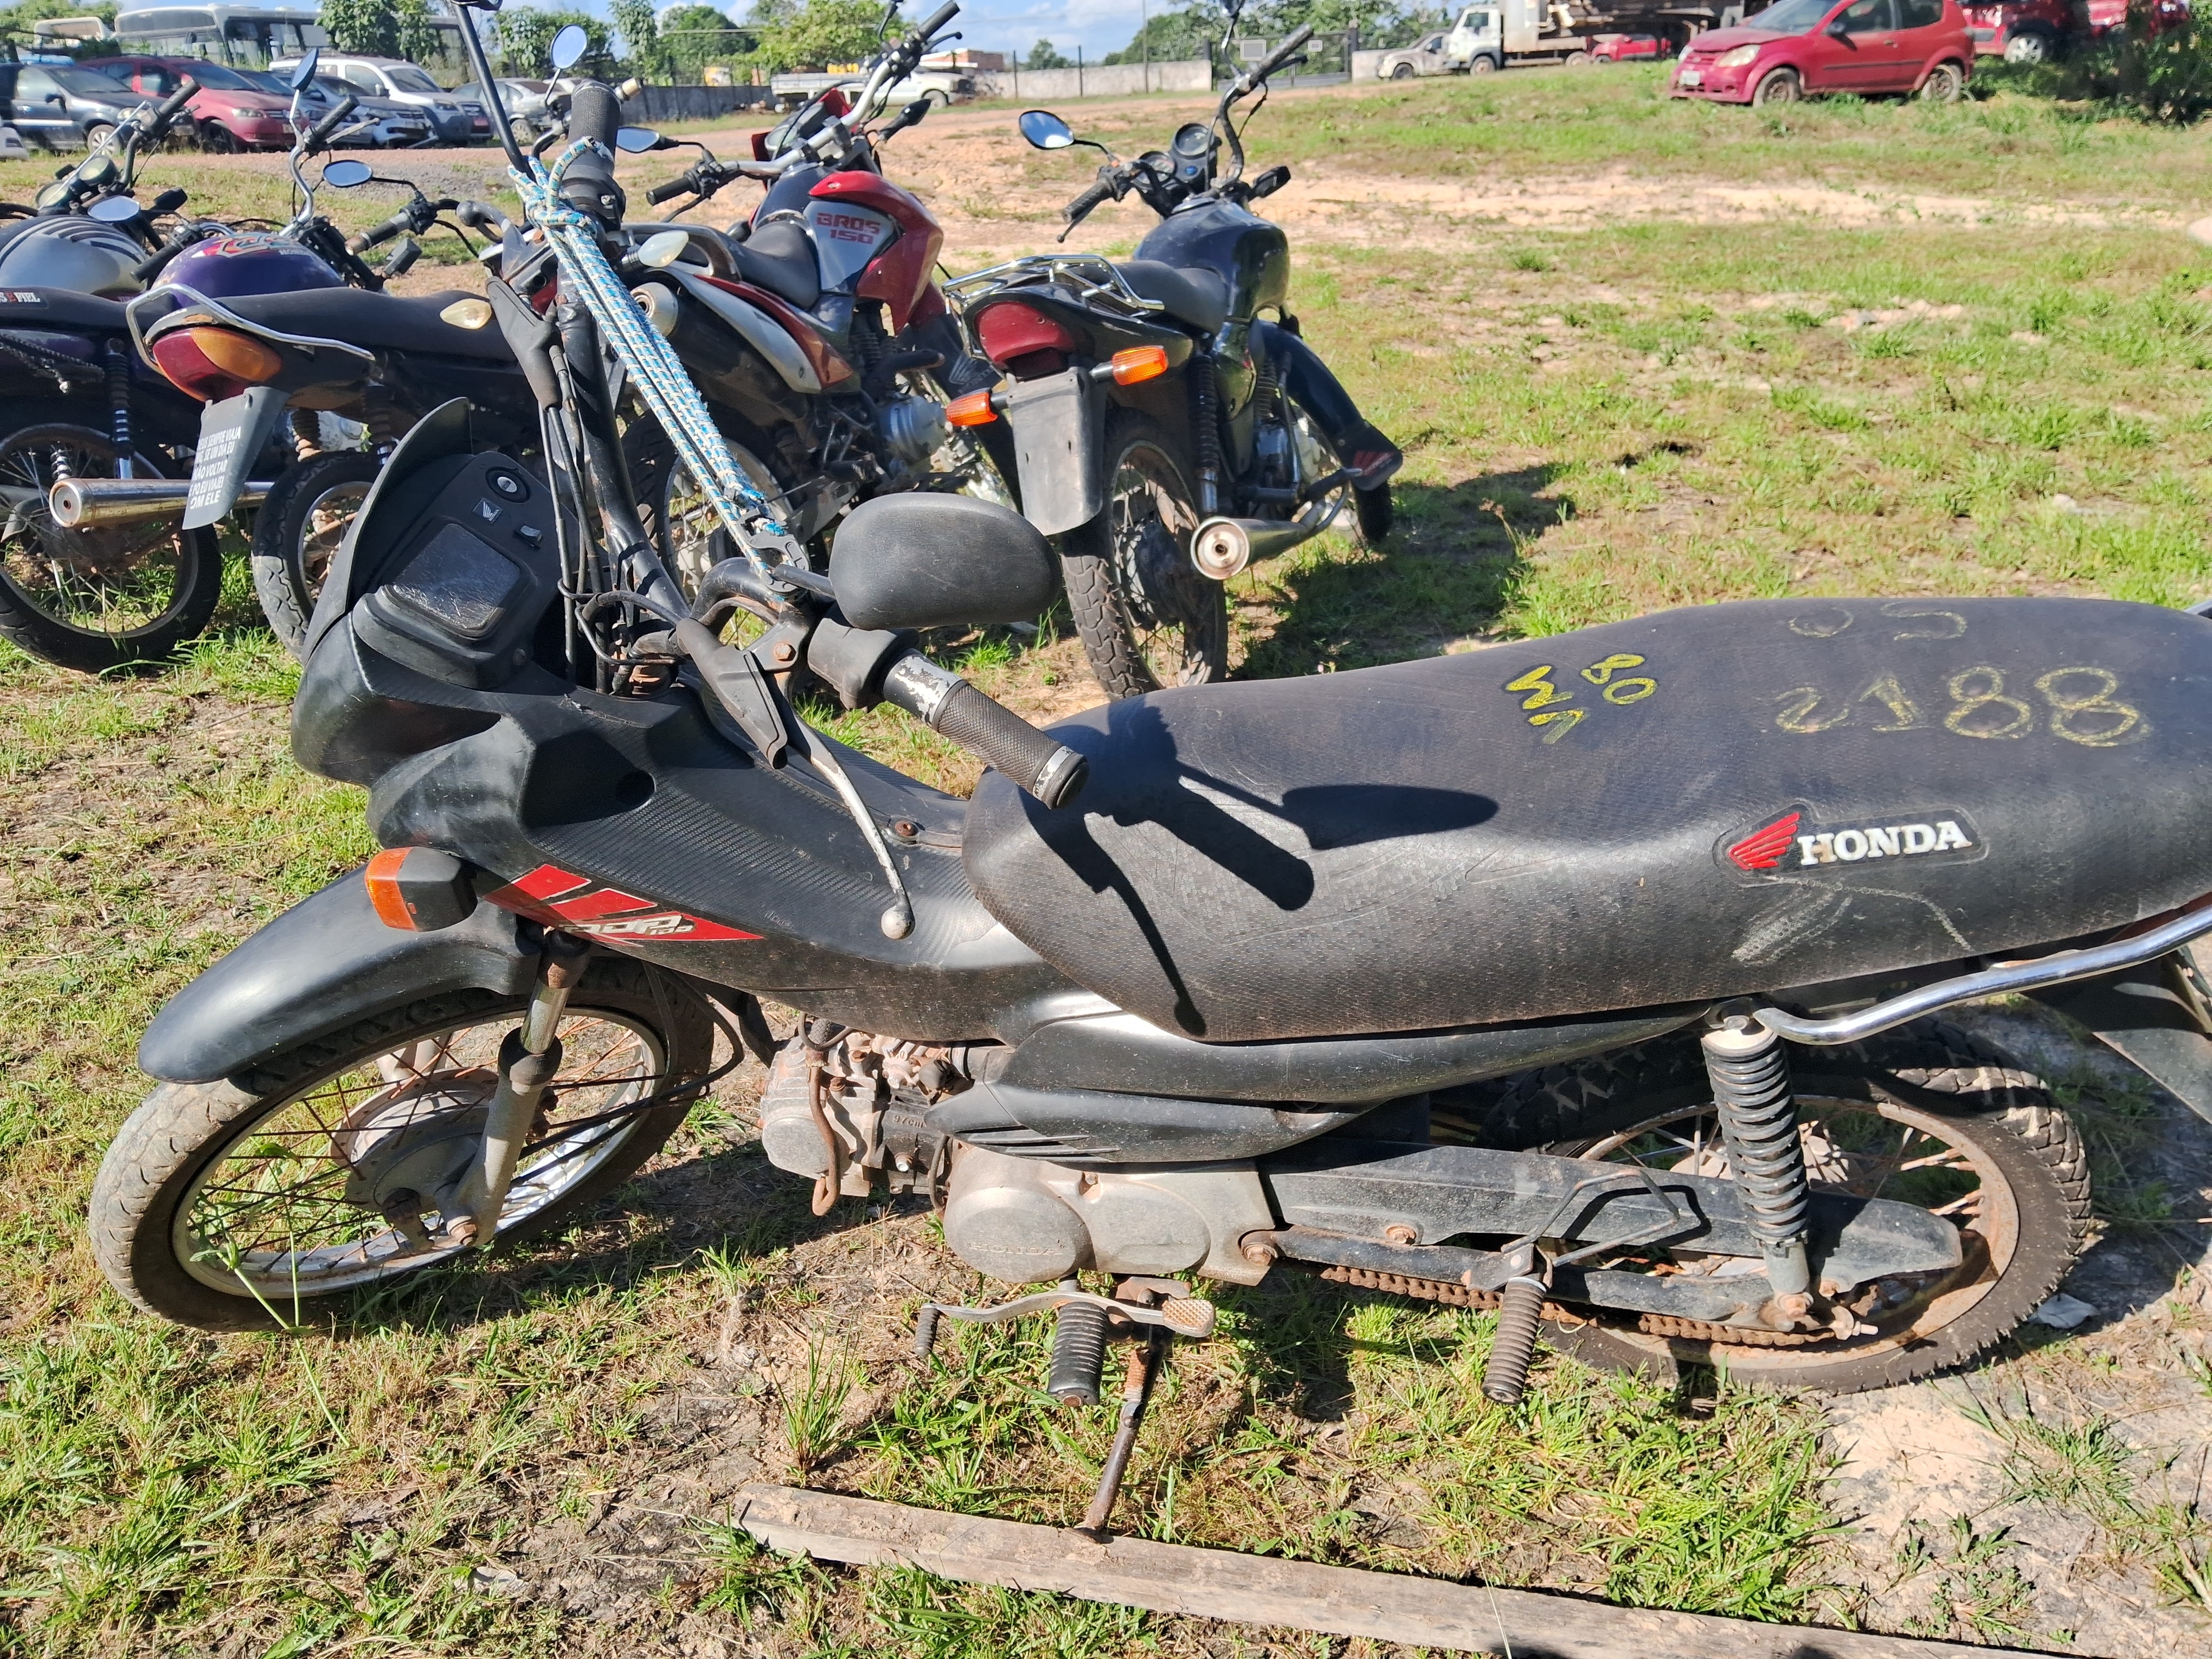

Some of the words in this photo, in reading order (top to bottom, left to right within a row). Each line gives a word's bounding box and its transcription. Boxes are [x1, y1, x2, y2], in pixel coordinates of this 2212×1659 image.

[816, 211, 880, 235] BROS
[830, 229, 873, 245] 150
[13, 292, 41, 303] FIEL
[208, 430, 227, 448] SEMPRE
[226, 426, 241, 442] VIAJA
[218, 442, 228, 457] DIA
[227, 440, 235, 454] EU
[205, 459, 228, 478] VOLTAR
[200, 480, 209, 494] EU
[208, 475, 225, 492] VIAJEI
[204, 490, 221, 506] ELE
[1774, 665, 2153, 747] 2188
[1797, 820, 1972, 866] HONDA
[967, 1241, 1064, 1256] HONDA
